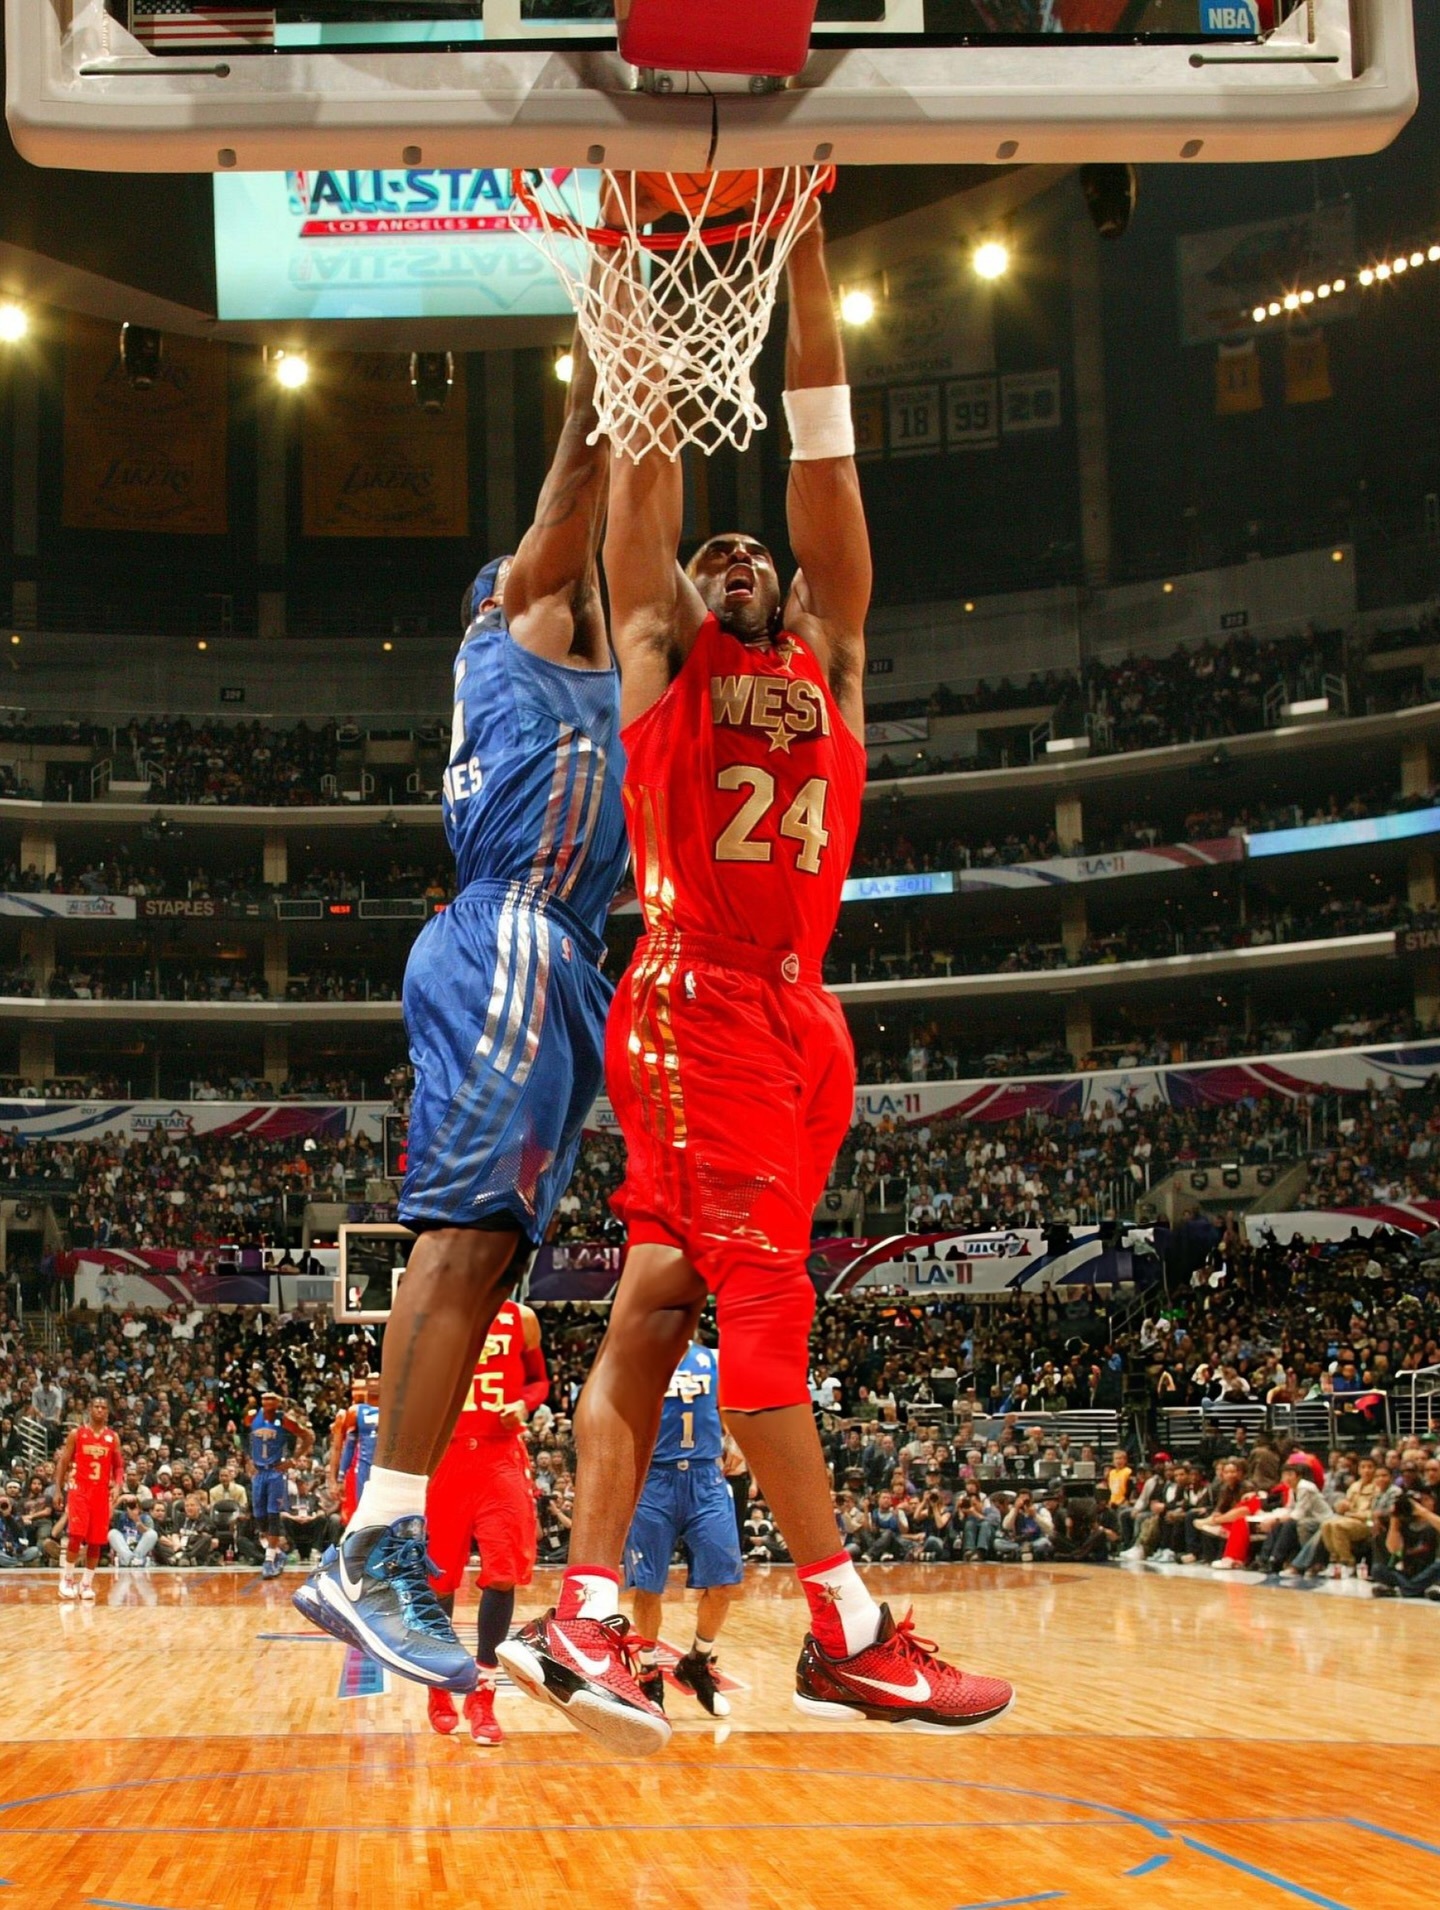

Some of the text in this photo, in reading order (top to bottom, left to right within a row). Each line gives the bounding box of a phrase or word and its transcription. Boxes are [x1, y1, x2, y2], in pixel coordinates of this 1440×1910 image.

[1208, 8, 1251, 29] NBA
[327, 220, 368, 232] LOS
[373, 218, 468, 231] ANGELES
[899, 405, 930, 438] 18
[953, 402, 990, 431] 99
[715, 765, 829, 875] 24
[146, 900, 215, 917] STAPLES
[680, 1411, 695, 1449] 1
[89, 1461, 101, 1480] 3
